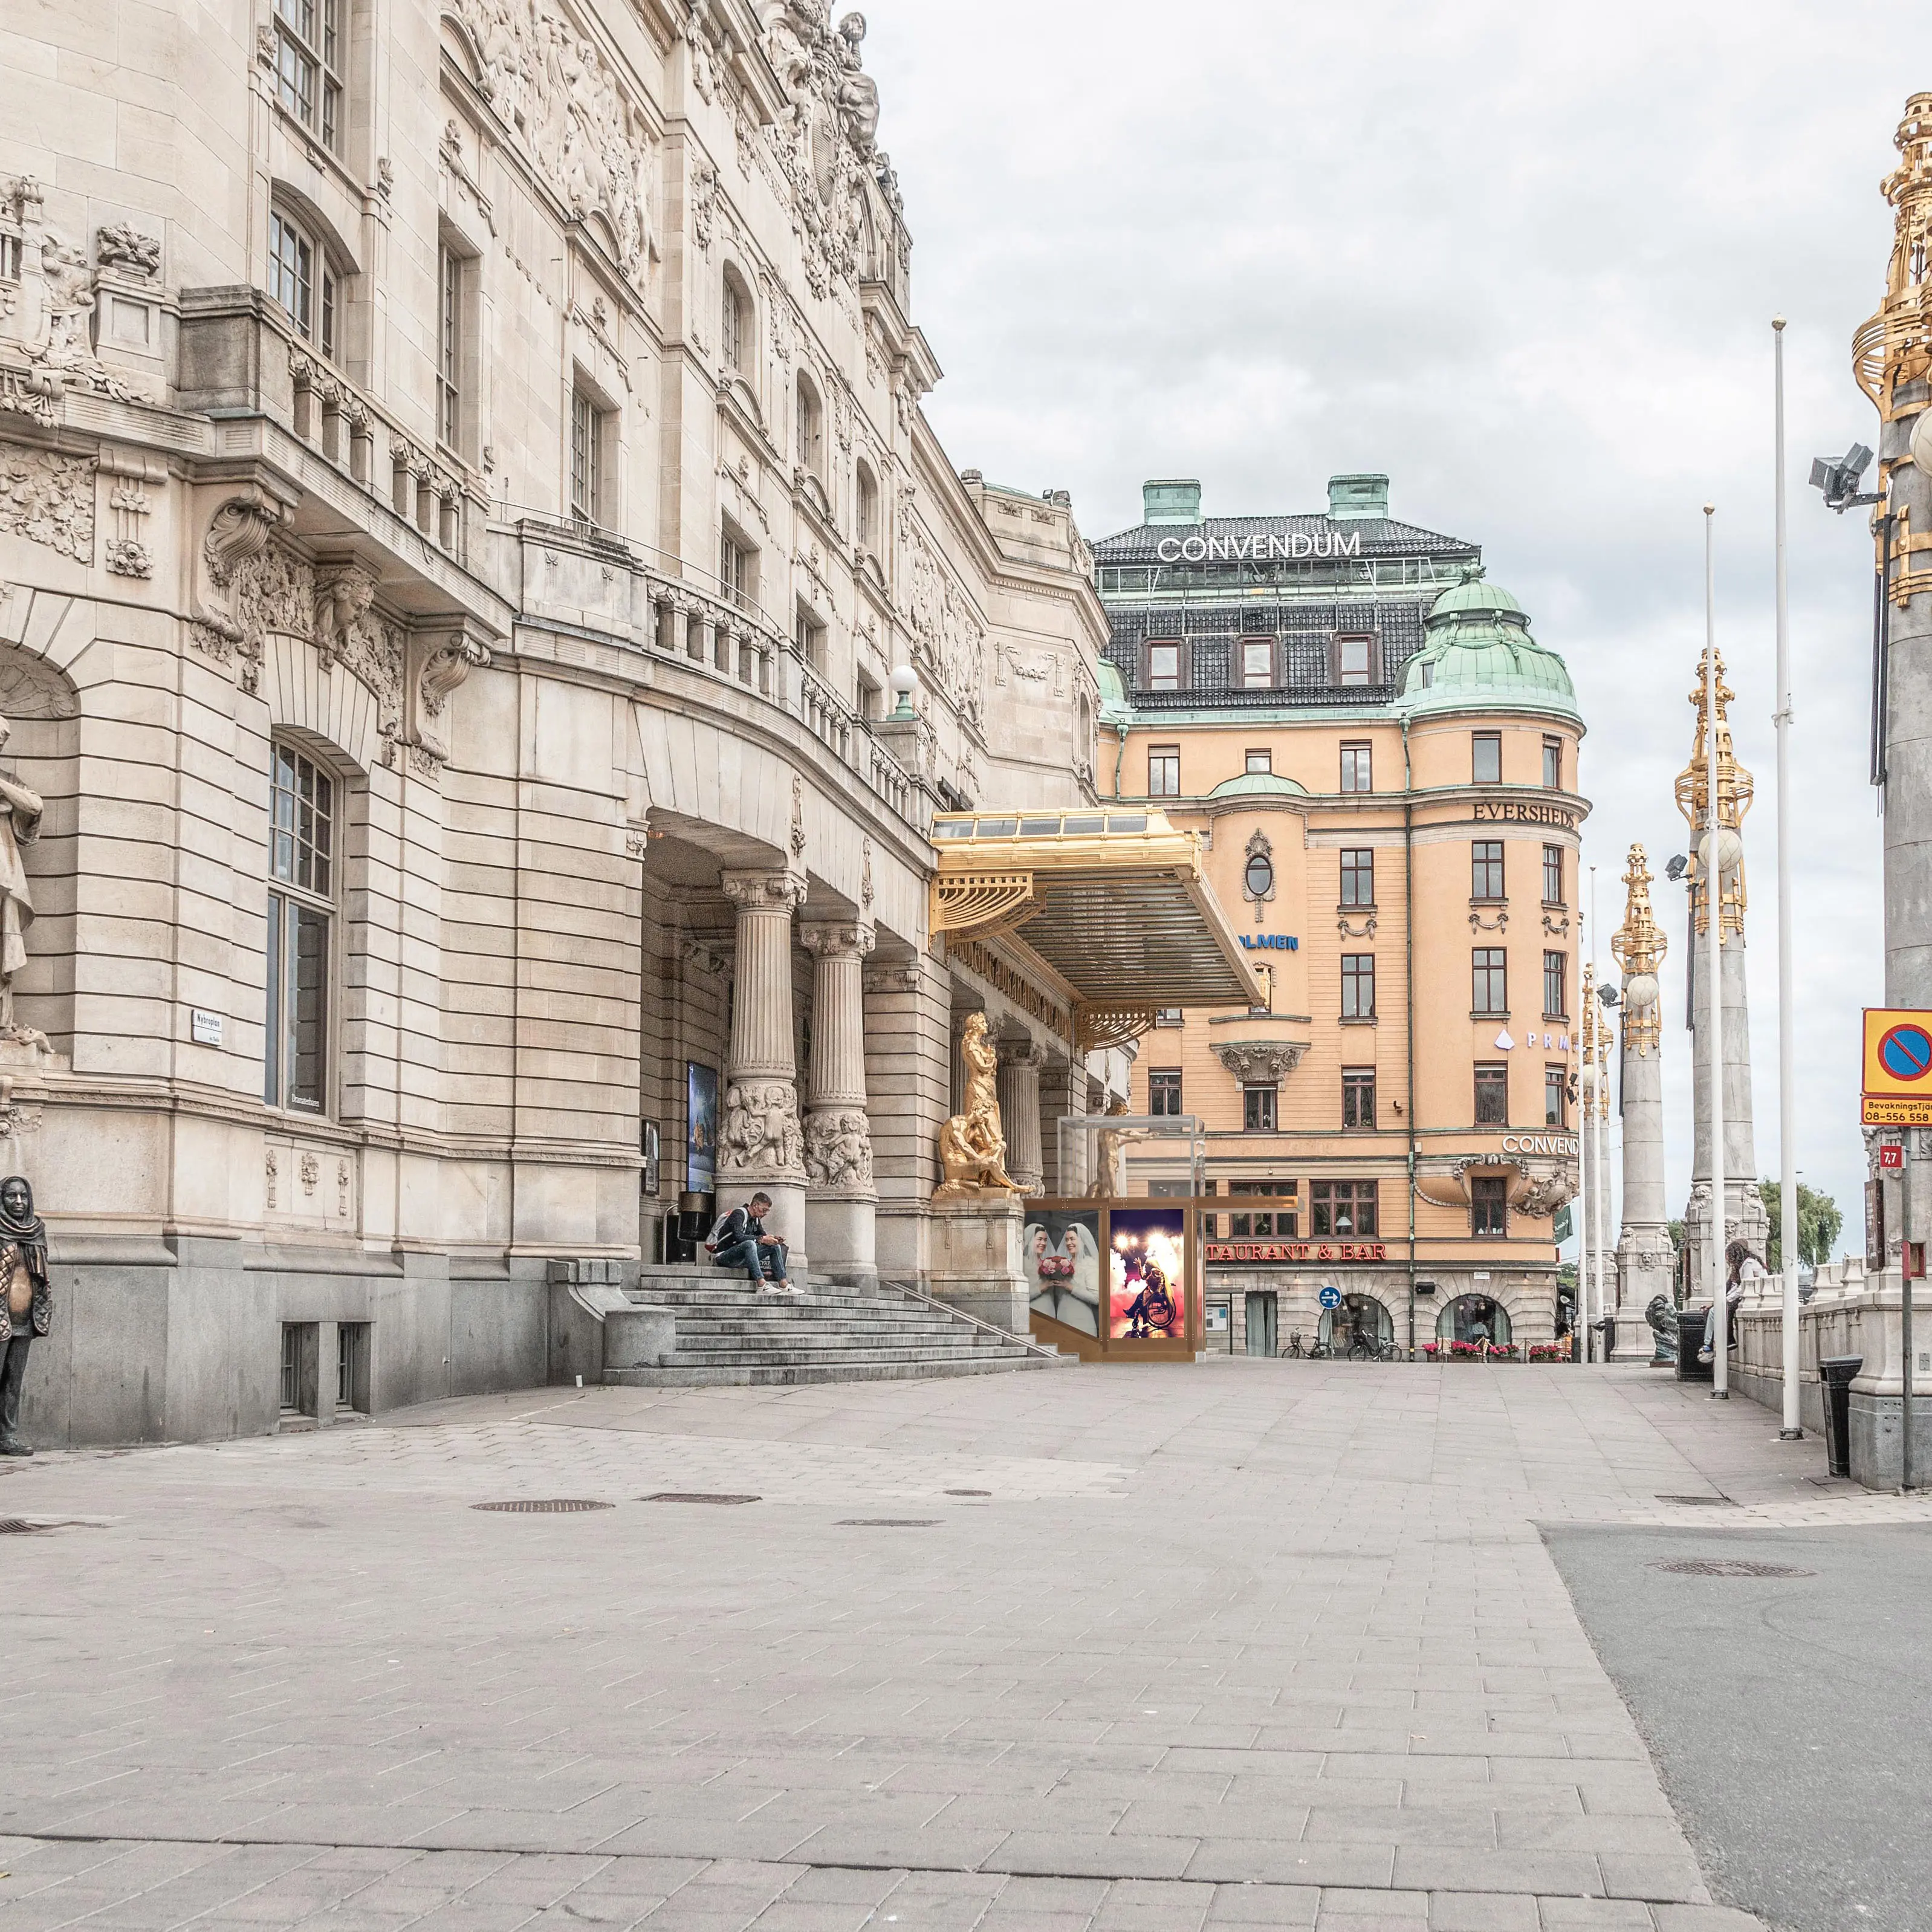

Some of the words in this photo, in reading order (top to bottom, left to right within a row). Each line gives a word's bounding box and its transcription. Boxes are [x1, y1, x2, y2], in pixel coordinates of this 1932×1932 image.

[1157, 531, 1360, 562] CONVENDUM
[1473, 803, 1575, 828] EVERSHEDS
[197, 1013, 220, 1027] Nybroplan
[1865, 1112, 1905, 1121] 08-556
[1909, 1113, 1929, 1121] 558
[1502, 1135, 1579, 1155] CONVEND
[1205, 1243, 1310, 1260] TAURANT
[1318, 1243, 1334, 1260] &
[1340, 1243, 1387, 1260] BAR
